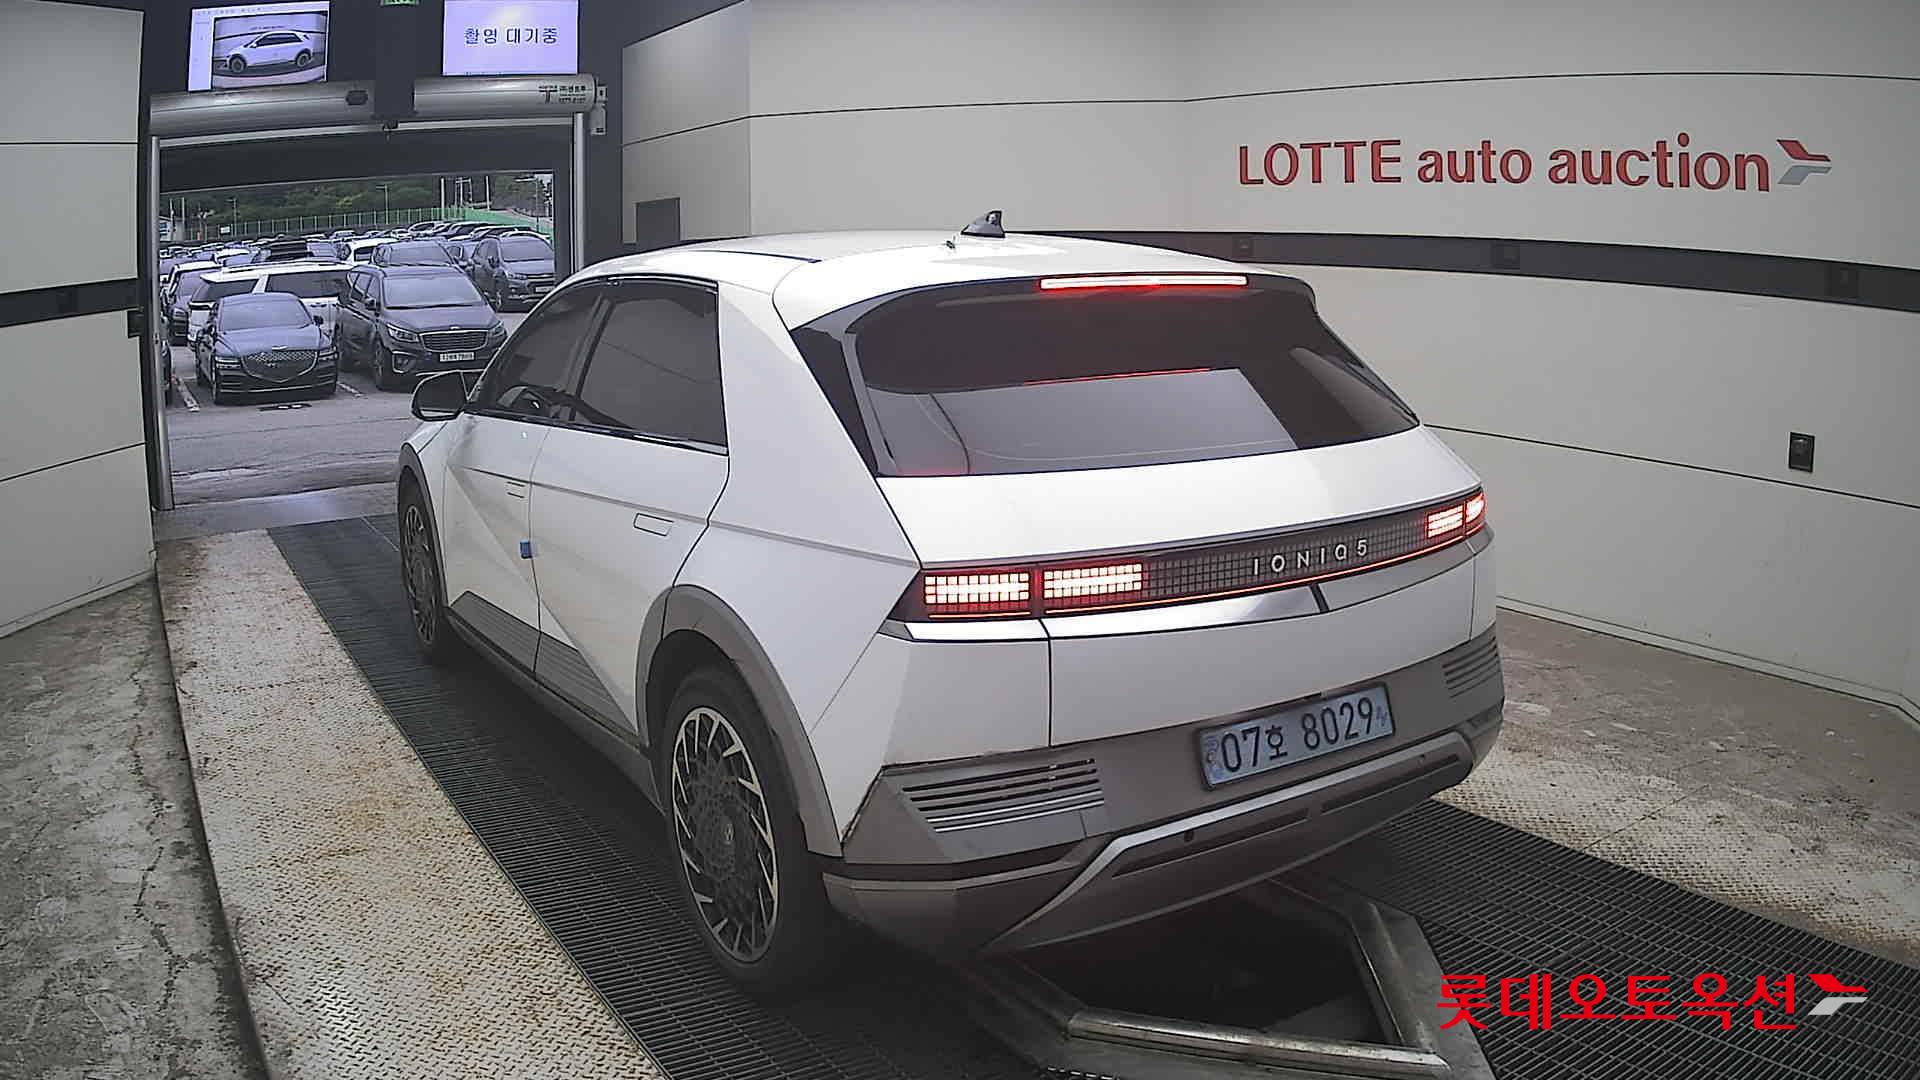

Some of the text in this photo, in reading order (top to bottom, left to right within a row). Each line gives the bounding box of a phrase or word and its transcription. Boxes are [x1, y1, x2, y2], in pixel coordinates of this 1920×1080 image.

[465, 28, 557, 45] 촬영 대기중
[1239, 131, 1770, 192] LOTTE auto auction
[1221, 697, 1374, 773] 07호 8029
